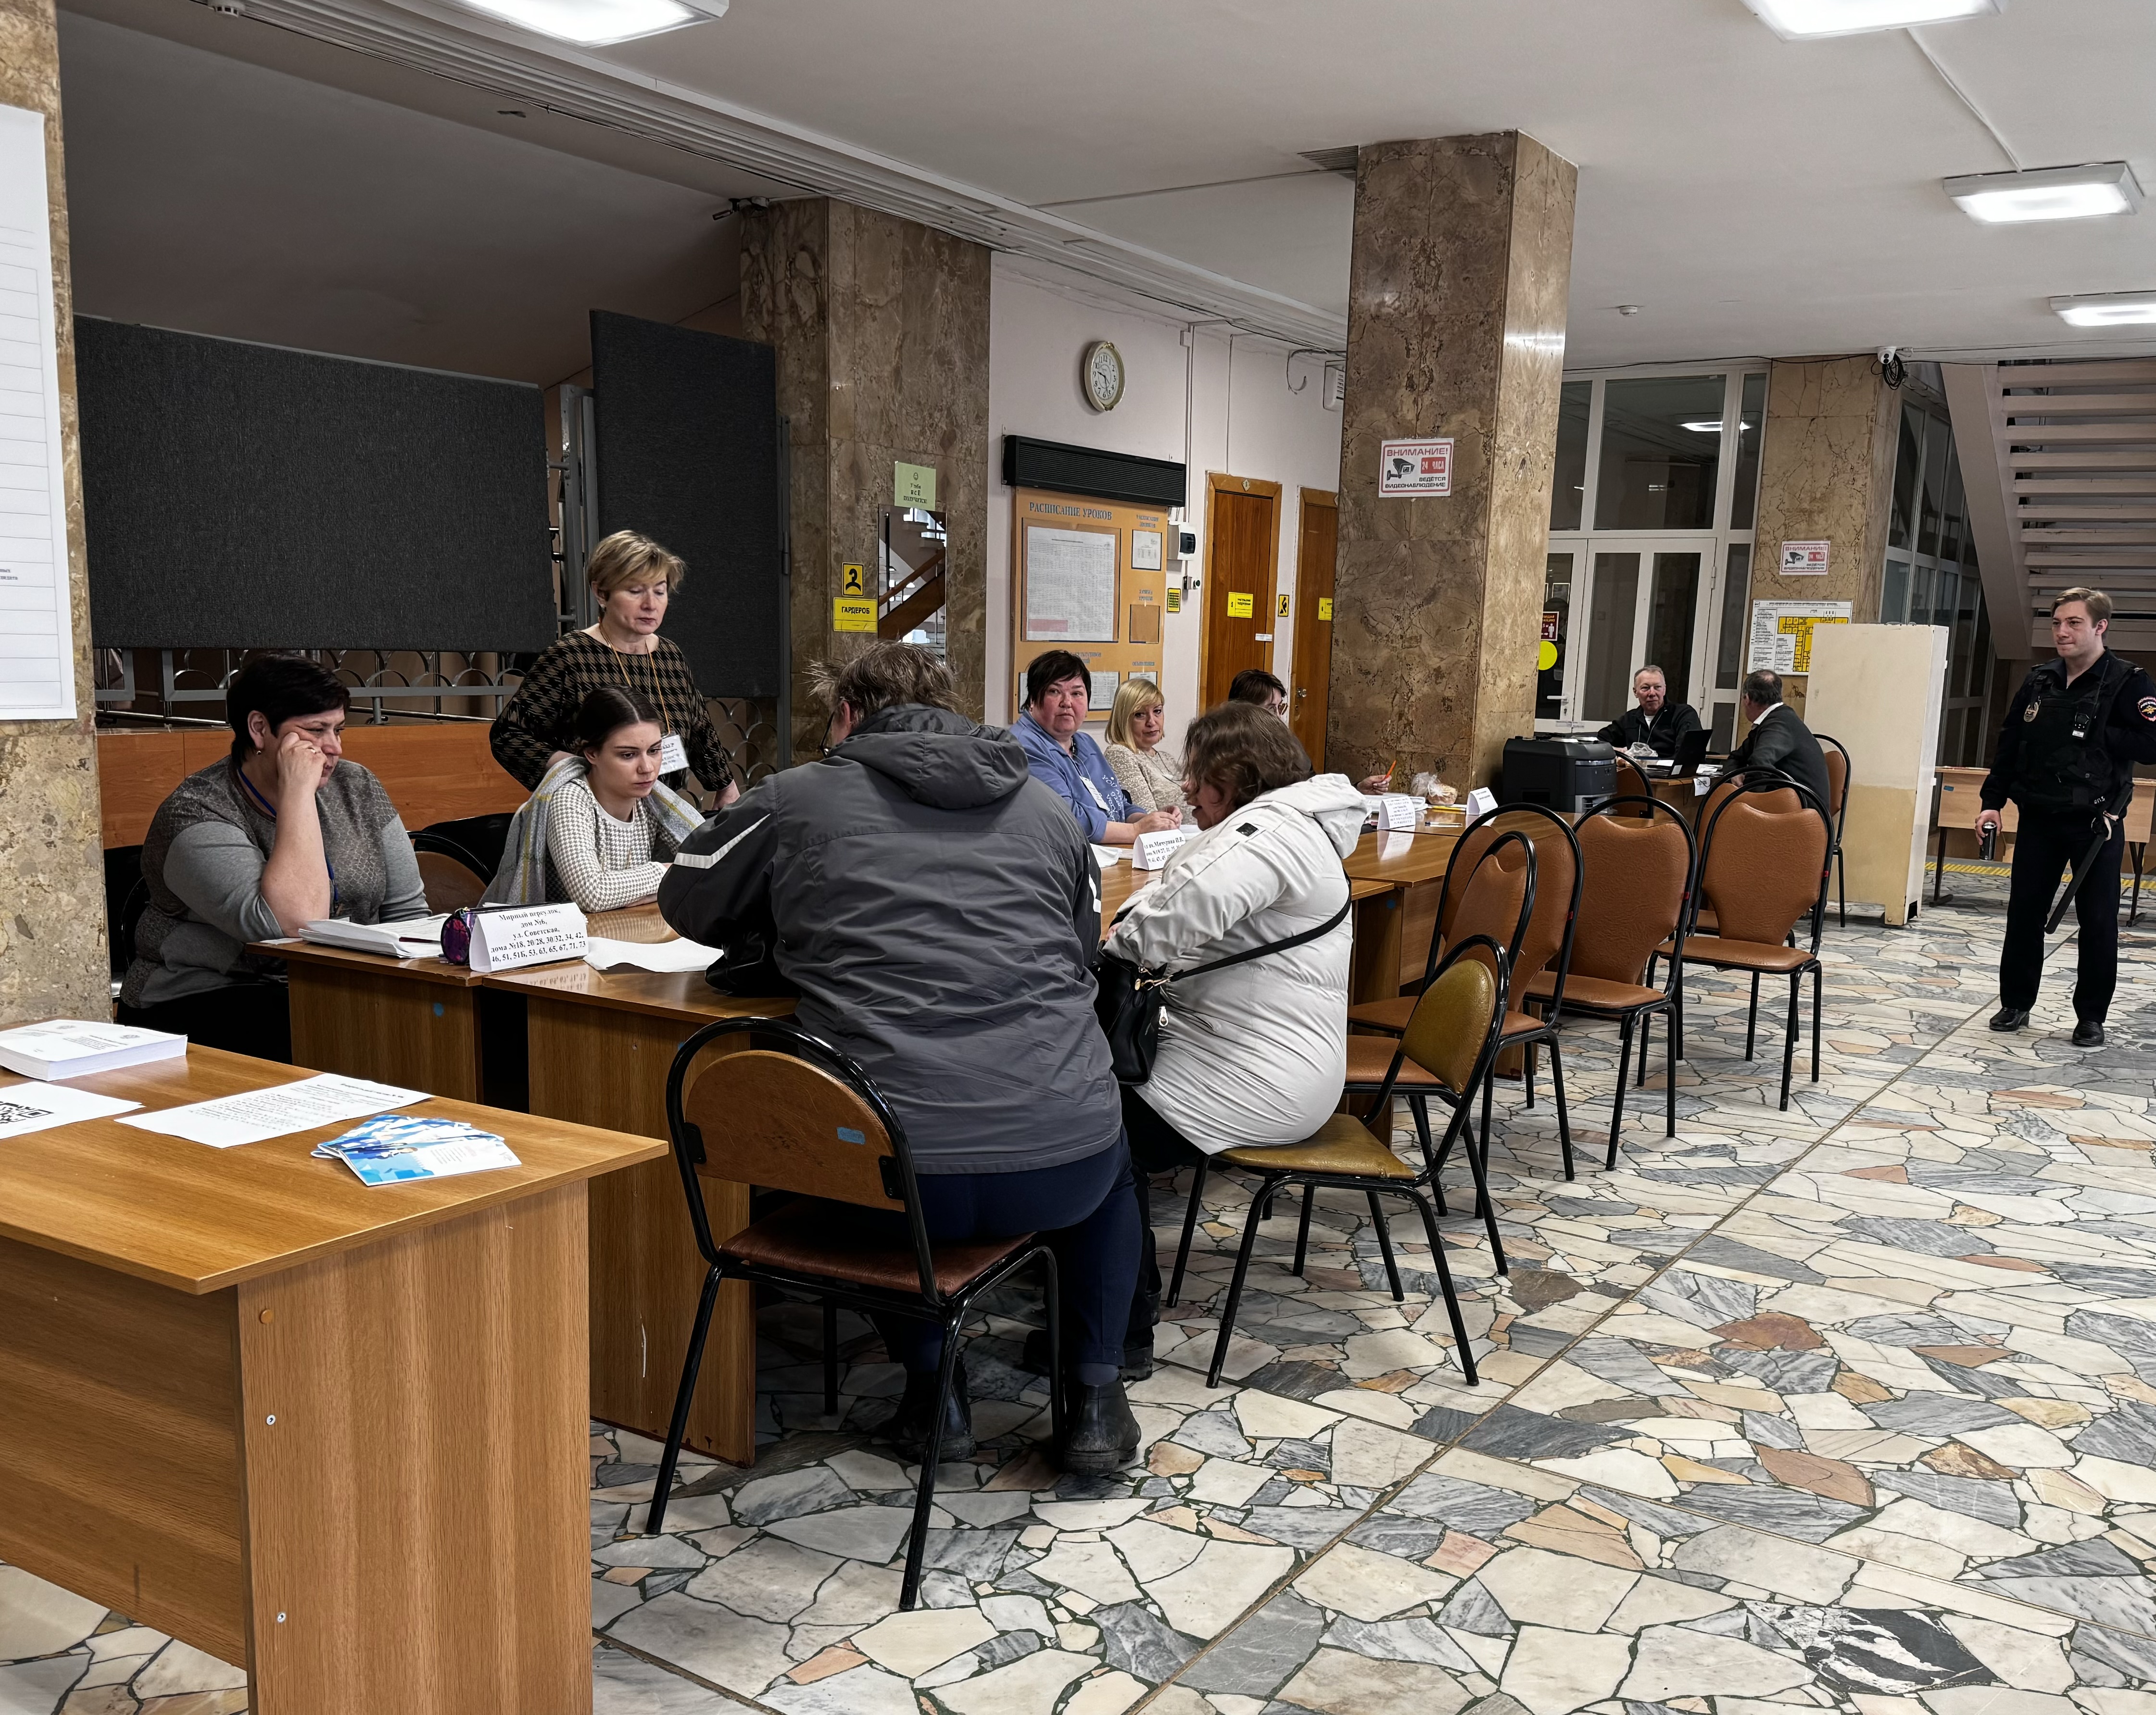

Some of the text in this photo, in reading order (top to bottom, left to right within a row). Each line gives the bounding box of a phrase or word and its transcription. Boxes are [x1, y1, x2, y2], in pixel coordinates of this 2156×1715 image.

[1387, 448, 1448, 456] ВНИМАНИЕ!
[1422, 461, 1444, 470] 24 ЧАСА
[1030, 502, 1112, 520] РАСПИСАНИЕ УРОКОВ
[1102, 775, 1117, 787] YOU
[499, 908, 560, 921] Мирный переулок,
[513, 927, 560, 941] ул. Советская,
[509, 941, 526, 950] №18,
[546, 935, 564, 944] 30/32,
